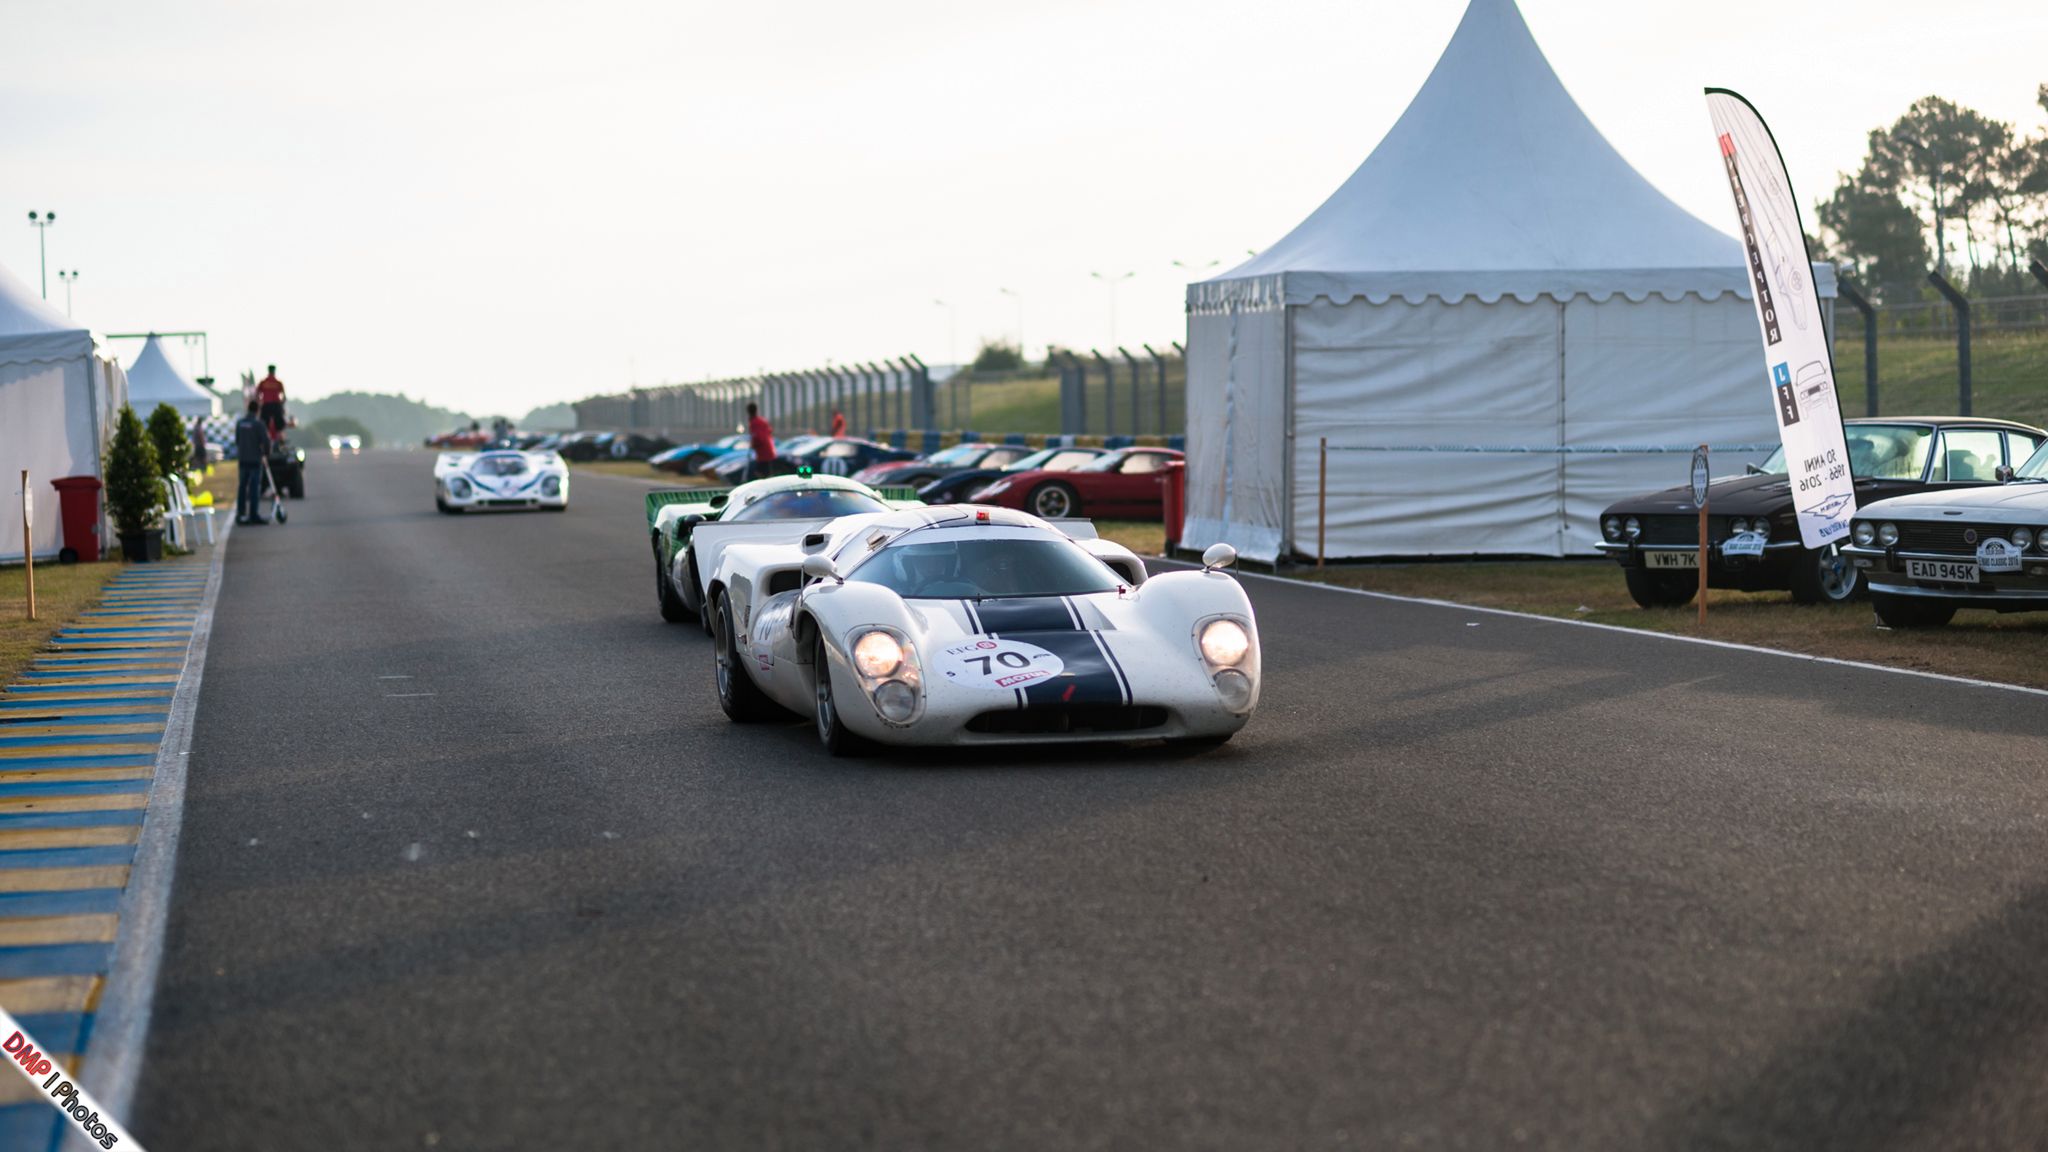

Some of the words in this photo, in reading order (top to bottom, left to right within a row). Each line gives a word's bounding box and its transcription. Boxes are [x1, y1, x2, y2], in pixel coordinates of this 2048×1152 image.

[1653, 552, 1679, 567] VWH
[1679, 552, 1697, 567] 7K
[1911, 561, 1937, 578] EAD
[1939, 563, 1974, 580] 945K
[963, 651, 1031, 676] 70
[998, 669, 1051, 687] MOTUL
